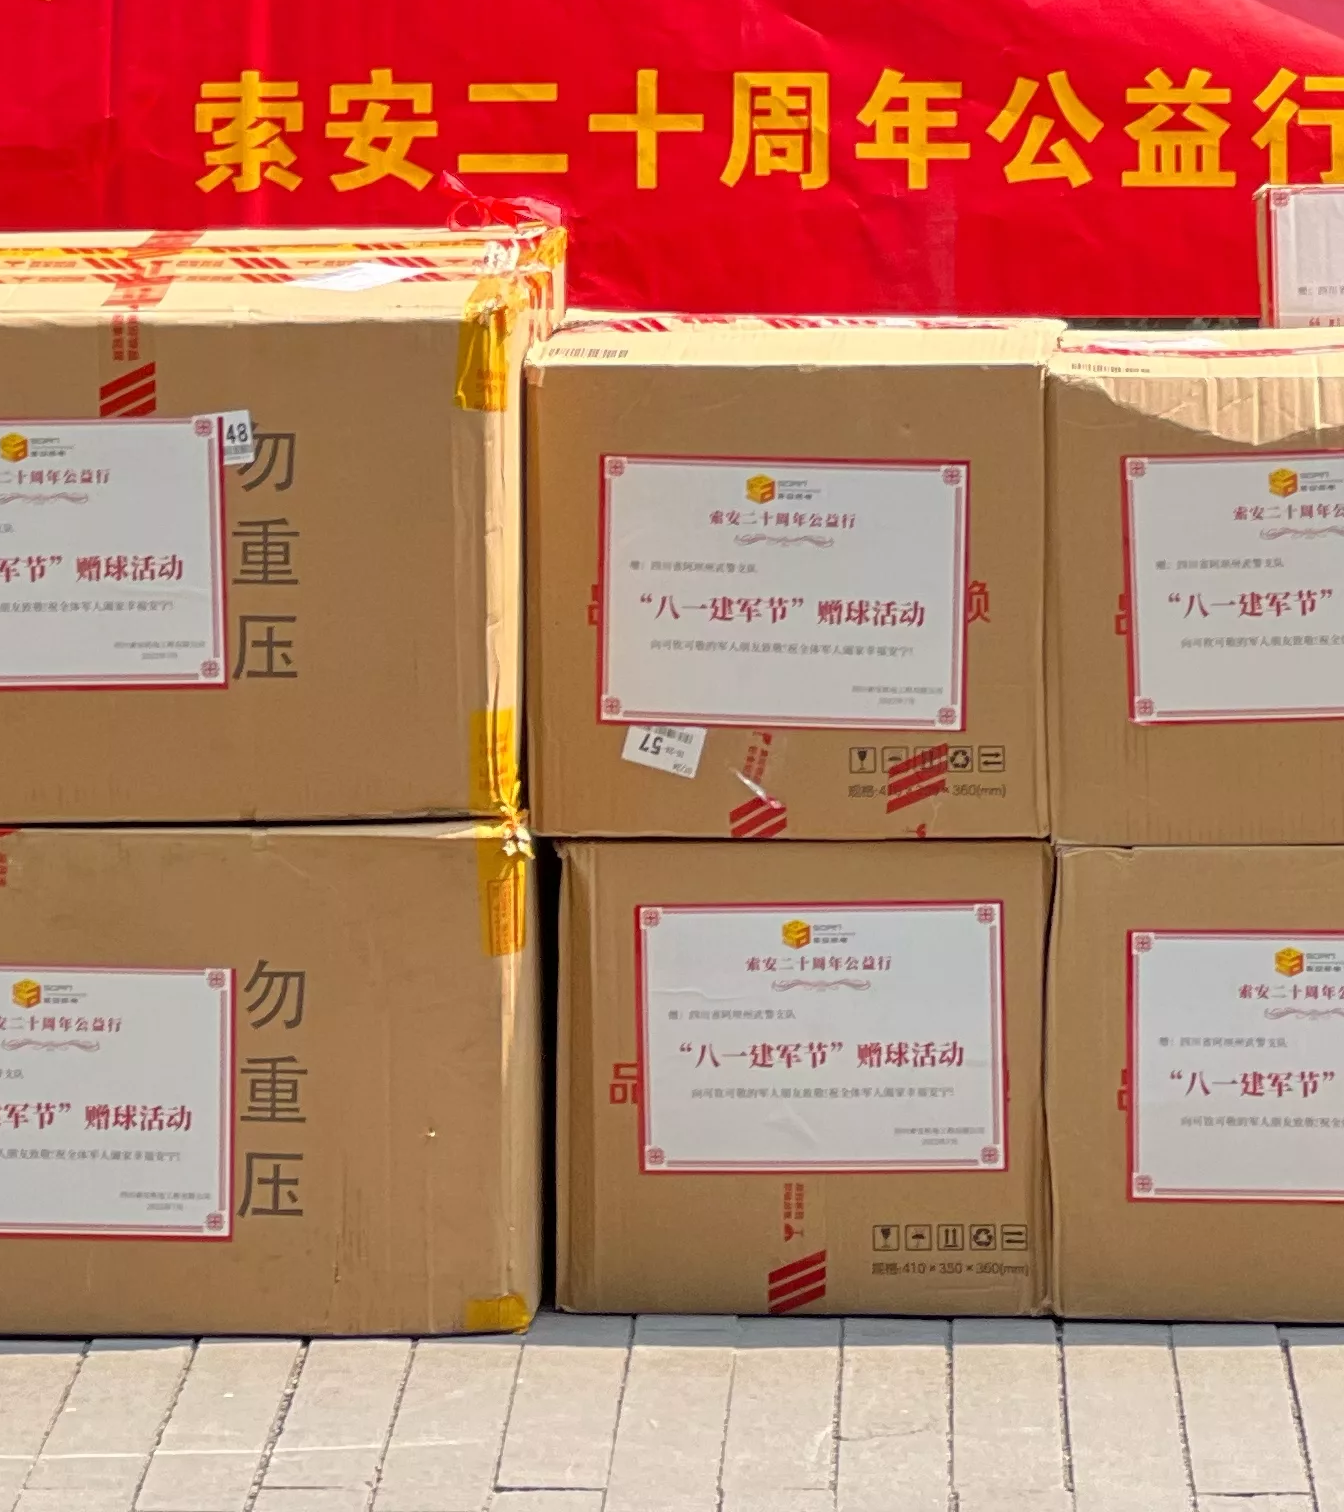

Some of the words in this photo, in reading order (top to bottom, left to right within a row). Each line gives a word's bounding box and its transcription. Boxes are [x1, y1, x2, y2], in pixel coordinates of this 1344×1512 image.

[226, 423, 248, 444] 48
[708, 510, 855, 528] 索安二十周年公益行
[232, 422, 300, 680] 勿重压
[745, 955, 891, 971] 索安二十周年公益行
[236, 959, 308, 1218] 勿重压
